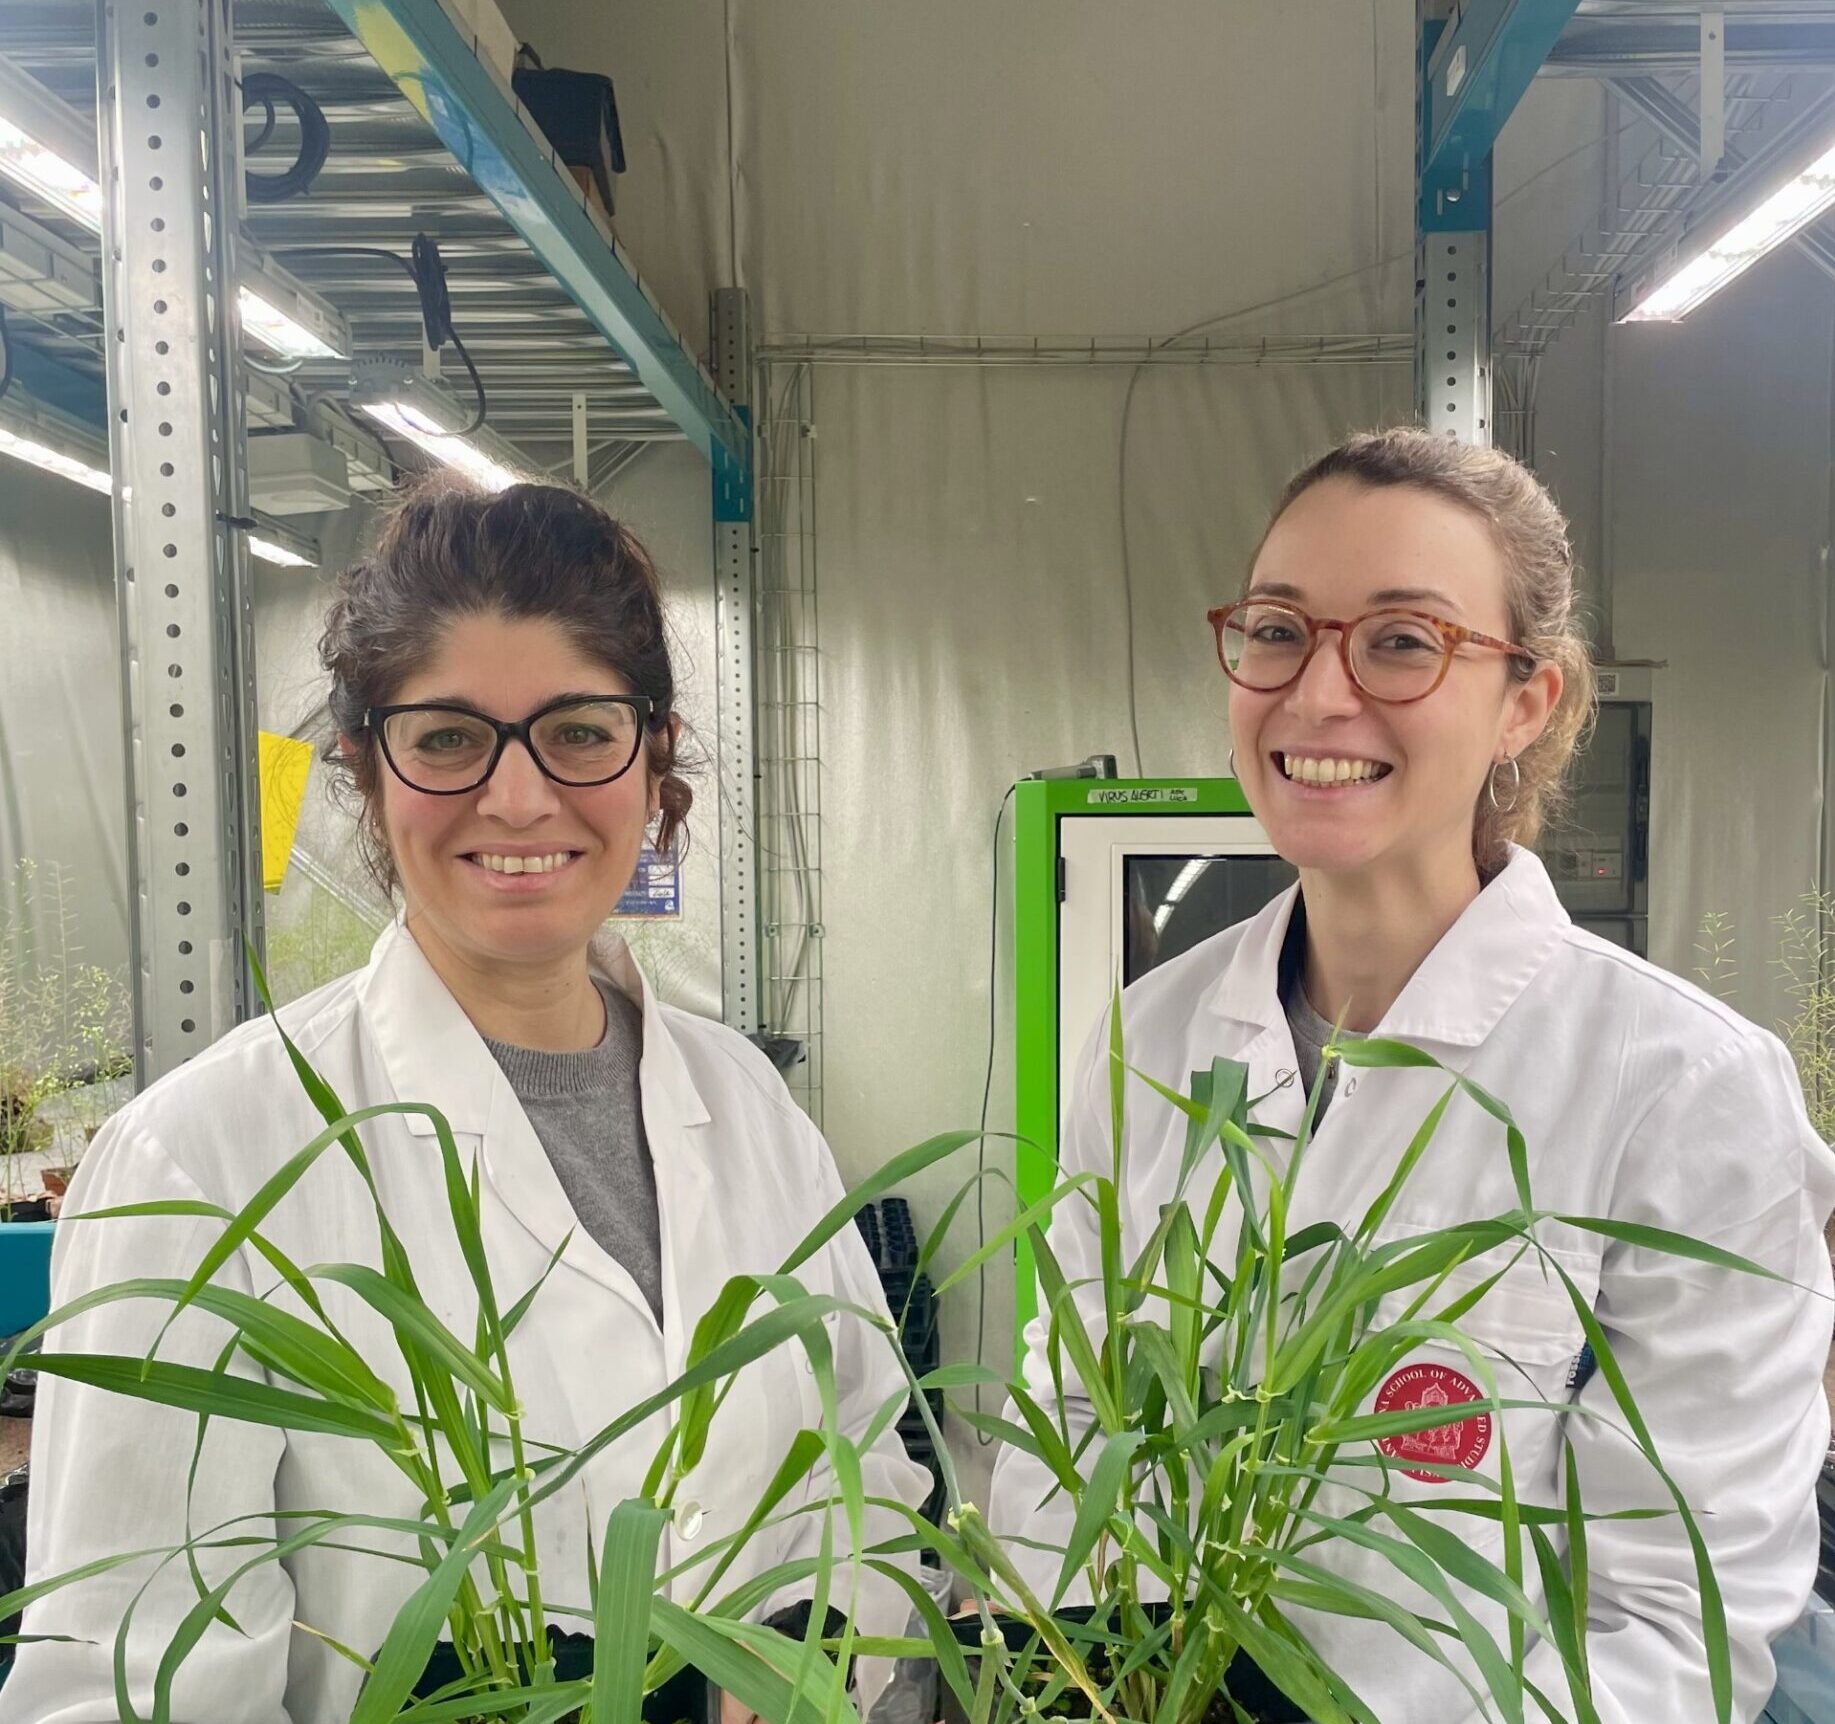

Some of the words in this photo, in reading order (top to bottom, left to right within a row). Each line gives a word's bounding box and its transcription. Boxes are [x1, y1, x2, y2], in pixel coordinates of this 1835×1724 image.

[1098, 790, 1128, 804] VIRUS
[1386, 1369, 1426, 1397] SCHOOL
[1430, 1369, 1447, 1380] OF
[1450, 1377, 1487, 1433] ADVAED
